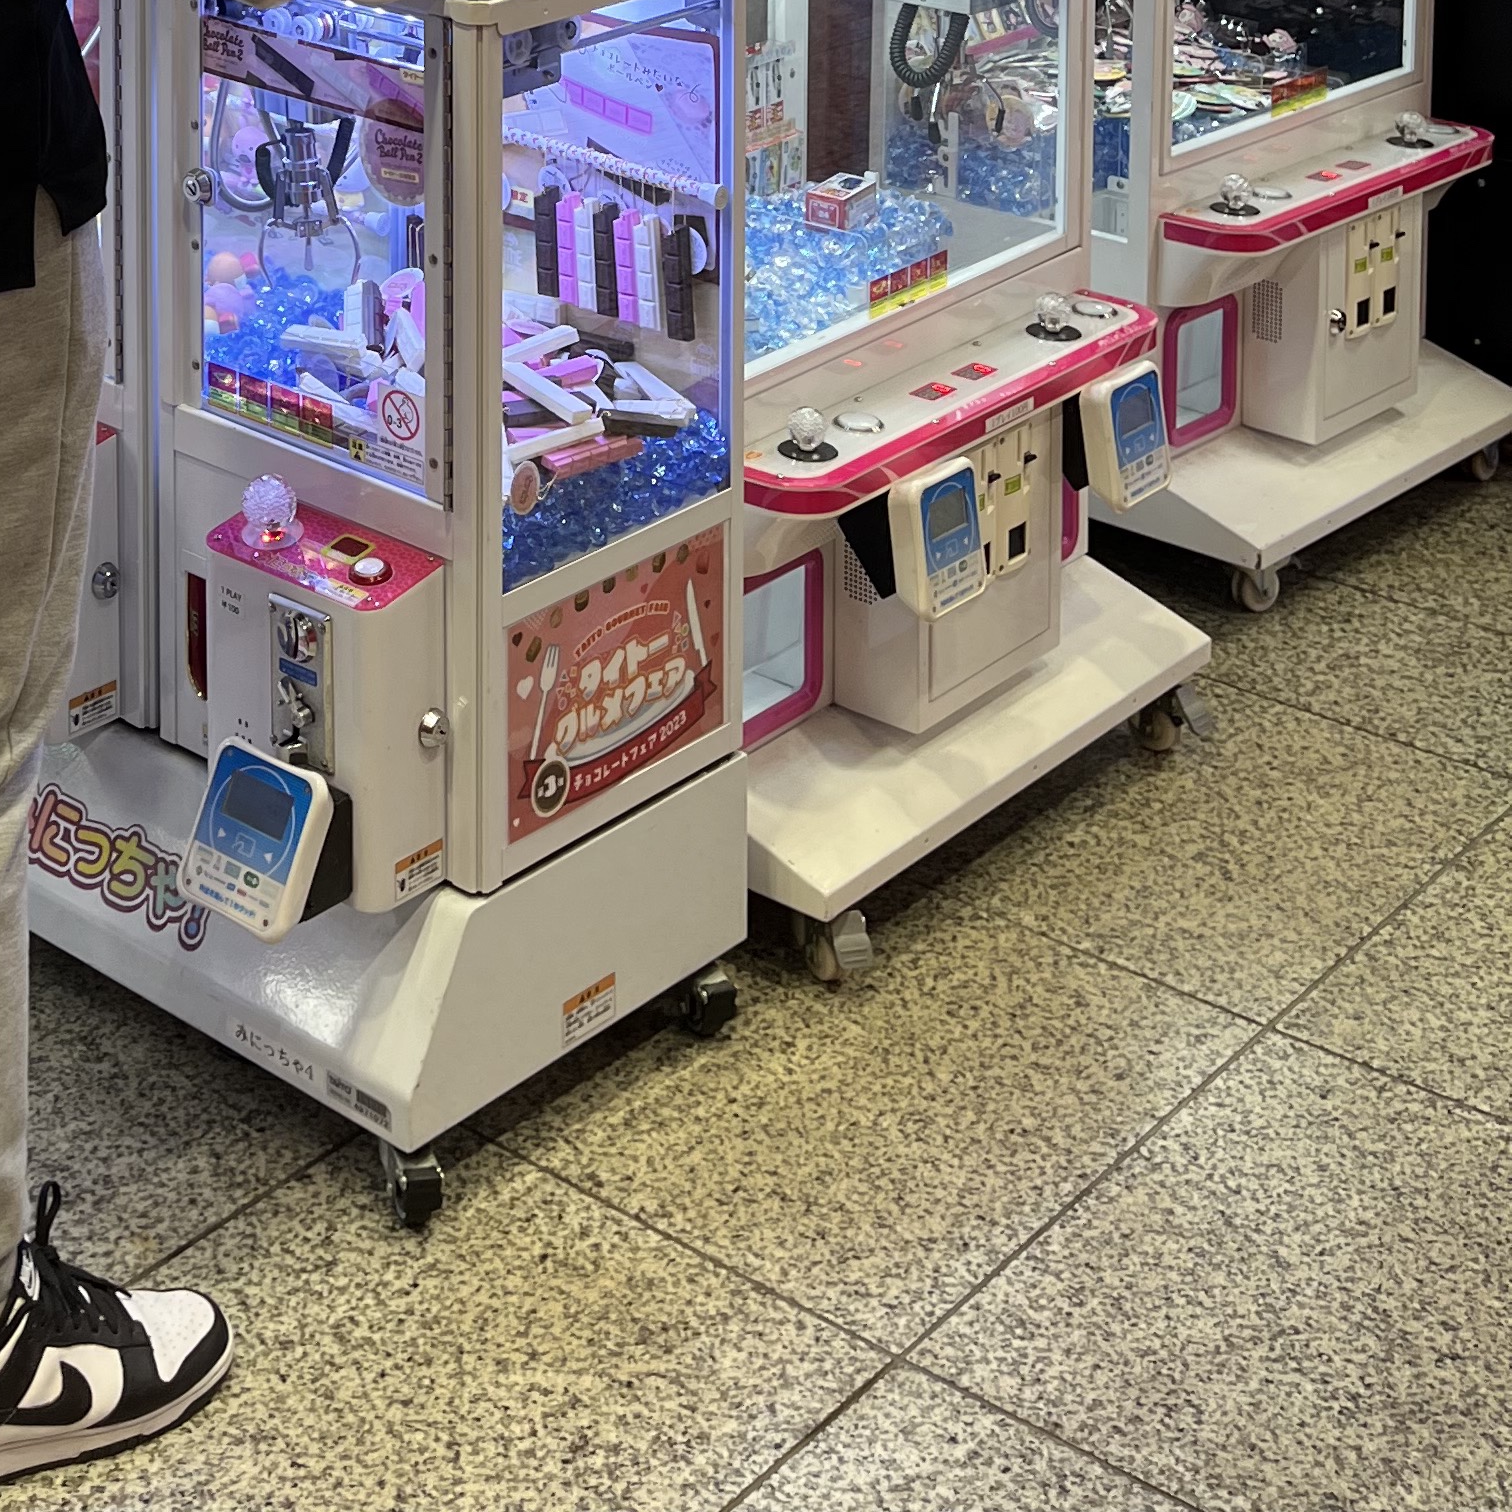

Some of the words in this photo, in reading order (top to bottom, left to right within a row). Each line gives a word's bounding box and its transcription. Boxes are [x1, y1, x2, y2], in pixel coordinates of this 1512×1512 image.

[374, 128, 424, 153] Chocolate
[375, 144, 400, 160] Ball
[399, 147, 416, 163] Pen
[579, 634, 670, 701] タイトー
[555, 658, 687, 756] グルメフェア
[573, 734, 658, 792] チョコレートフェア
[659, 710, 688, 743] 2023
[28, 786, 204, 946] にっちゃ!
